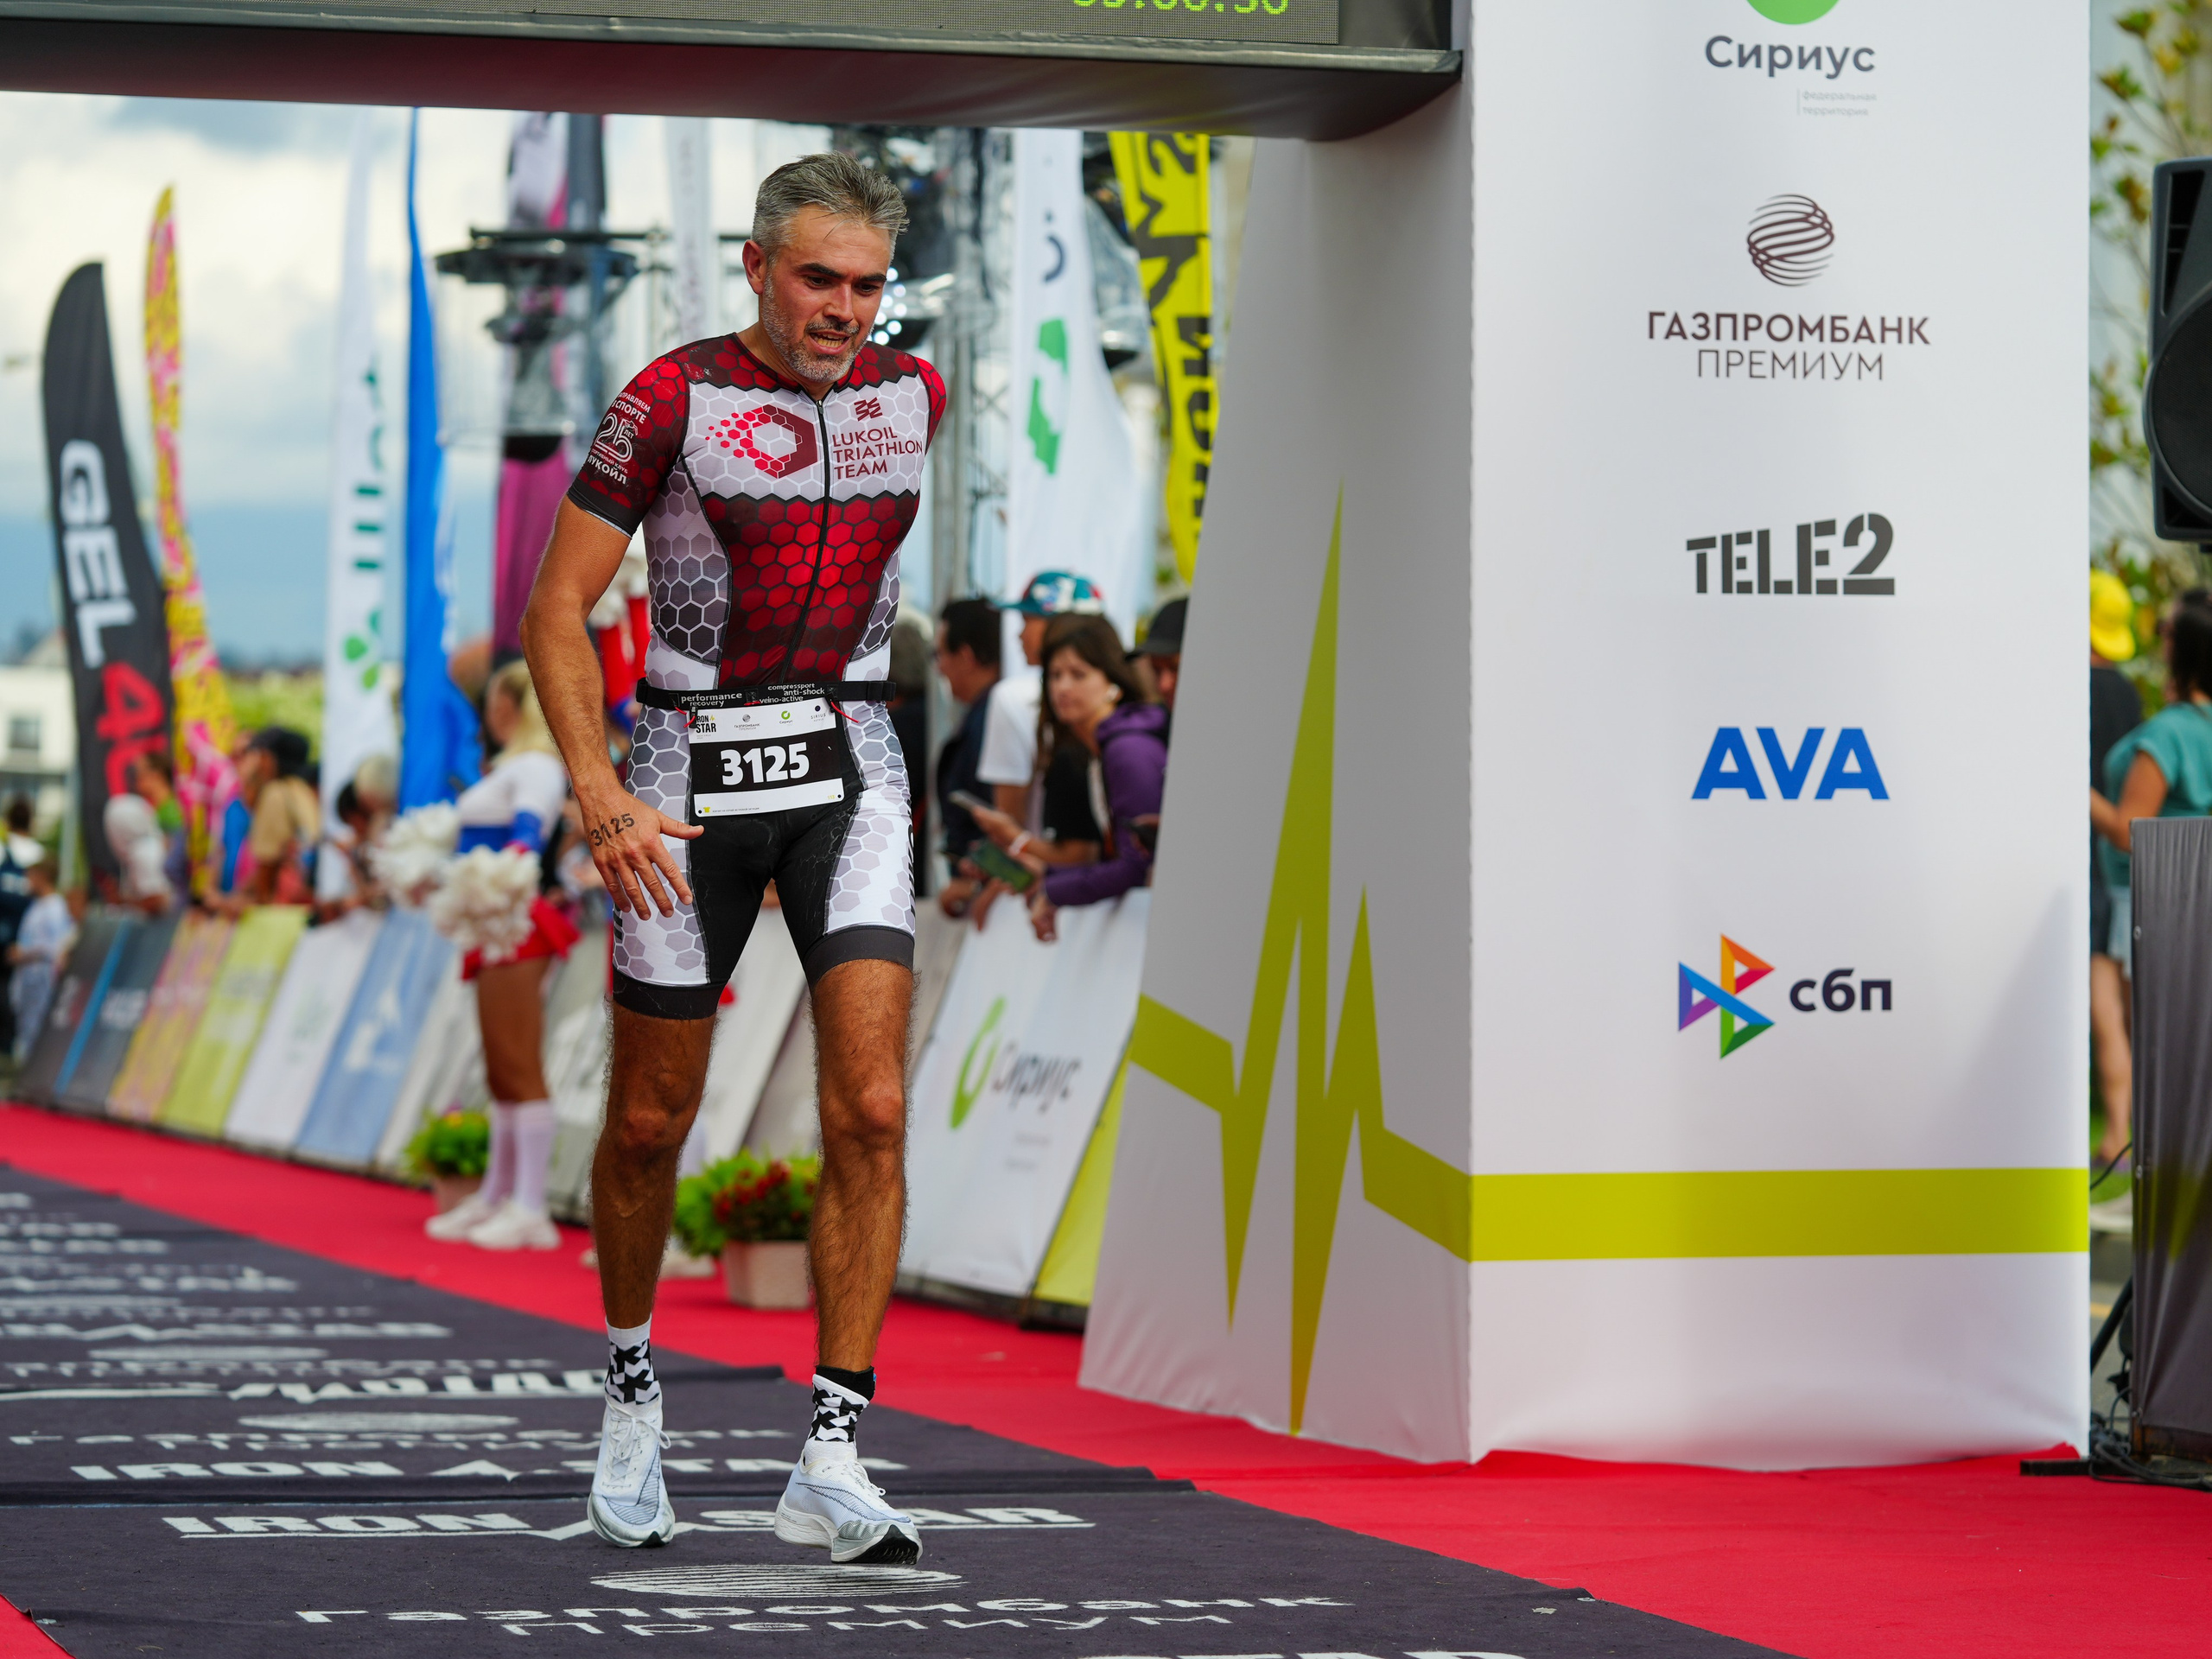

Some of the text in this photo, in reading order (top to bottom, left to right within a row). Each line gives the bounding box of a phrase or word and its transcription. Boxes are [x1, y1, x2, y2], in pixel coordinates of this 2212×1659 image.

[1705, 35, 1876, 79] Сириус
[1648, 311, 1930, 346] ГАЗПРОМБАНК
[1698, 349, 1884, 381] ПРЕМИУМ
[594, 412, 632, 462] 25
[832, 426, 898, 448] LUKOIL
[833, 440, 923, 463] TRIATHLON
[588, 454, 627, 485] ЛУКОЙЛ
[834, 459, 887, 480] TEAM
[1686, 513, 1896, 596] TELE2
[681, 692, 742, 703] performance
[690, 699, 725, 708] recovery
[784, 688, 824, 696] anti-shock
[696, 722, 716, 733] STAR
[720, 742, 810, 786] 3125
[1691, 727, 1891, 800] AVA
[590, 813, 635, 846] 3125
[1789, 968, 1892, 1013] сбп
[70, 1461, 405, 1481] IRON
[162, 1513, 533, 1535] IRON
[698, 1507, 1086, 1528] SAR
[296, 1596, 1356, 1624] Газпромбанк
[500, 1614, 1234, 1637] Премиум
